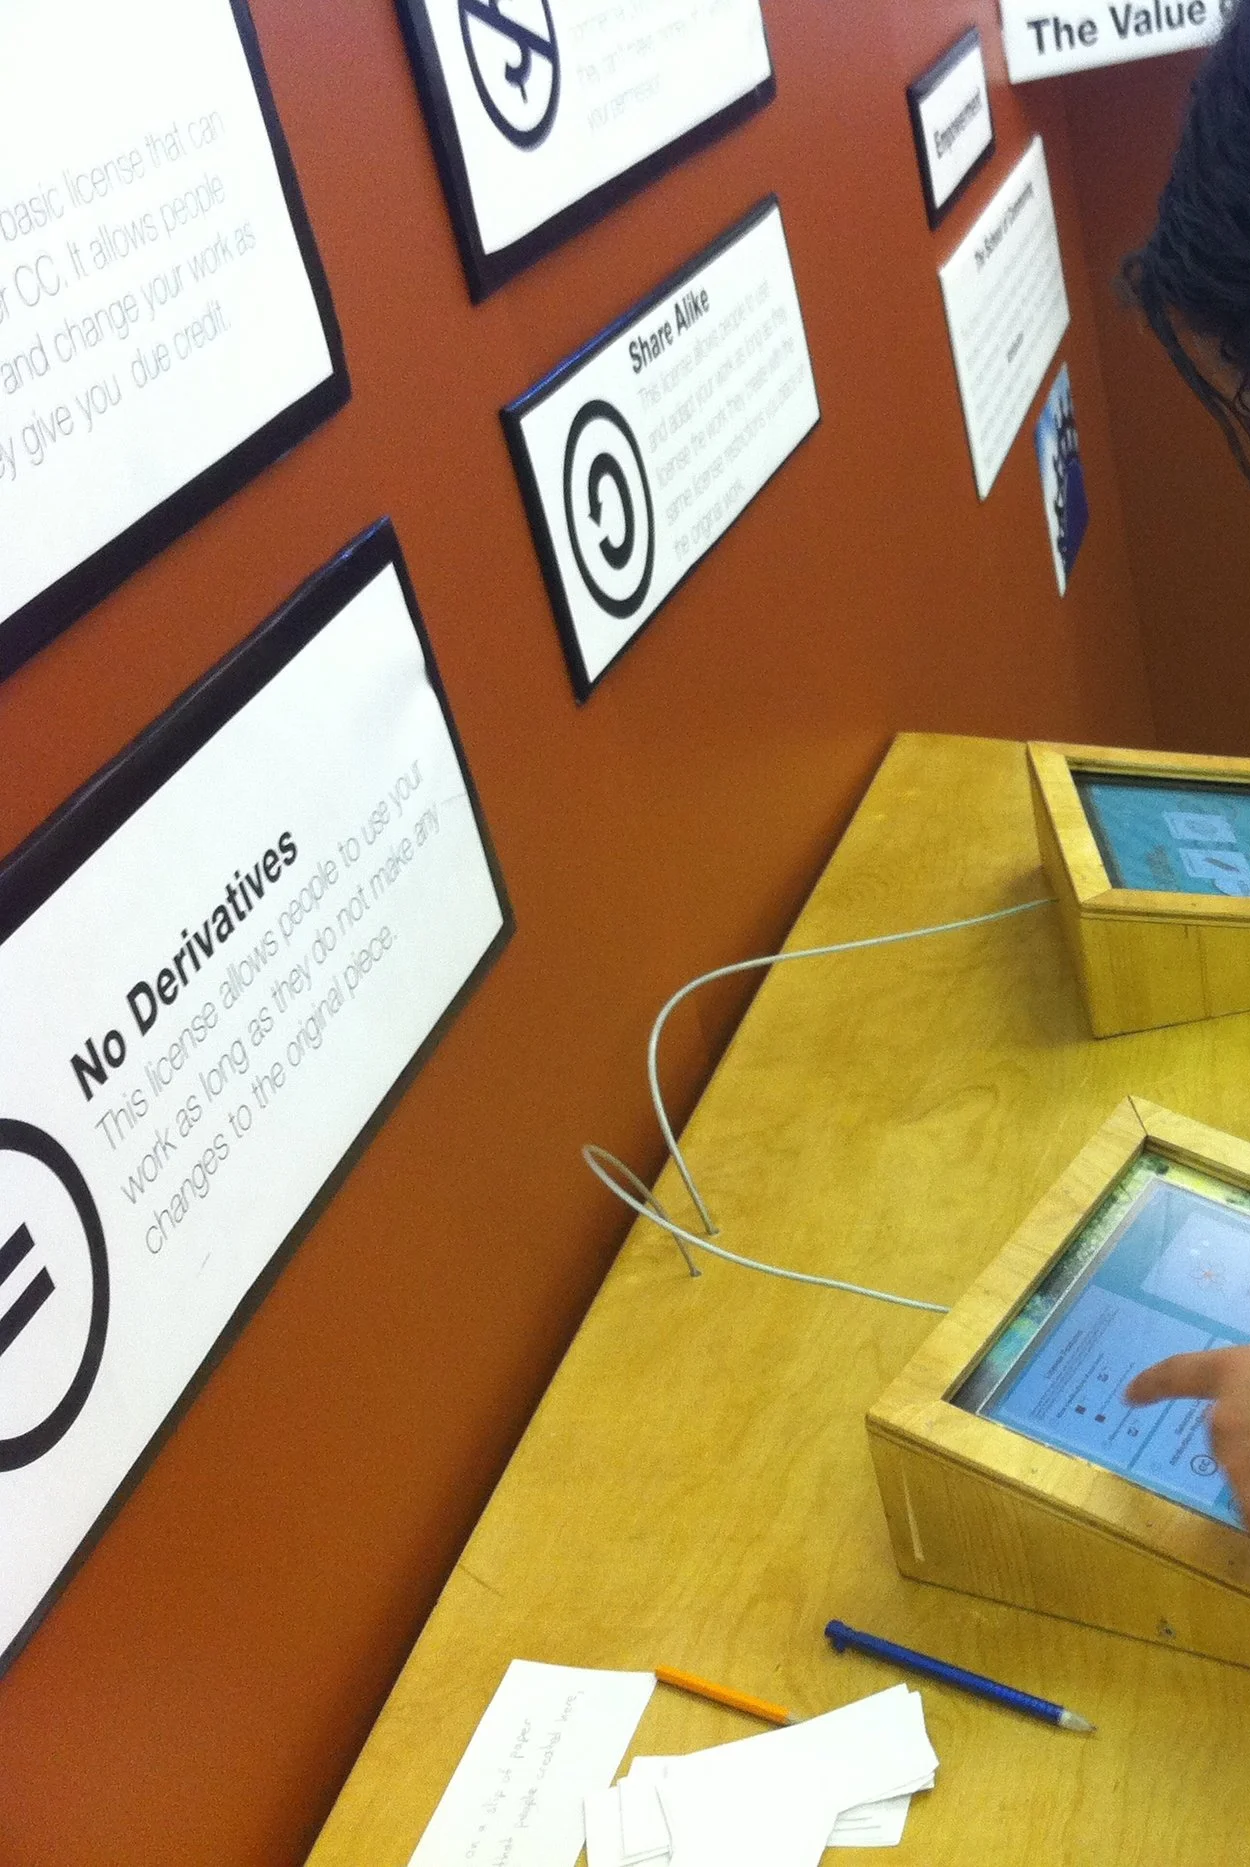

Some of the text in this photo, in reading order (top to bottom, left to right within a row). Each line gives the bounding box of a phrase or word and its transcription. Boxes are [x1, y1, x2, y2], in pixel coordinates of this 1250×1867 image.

[1027, 17, 1099, 55] The
[1109, 0, 1207, 40] Value
[62, 148, 145, 207] license
[144, 122, 187, 168] that
[188, 111, 223, 149] can
[89, 213, 159, 270] allows
[159, 173, 225, 238] people
[0, 222, 256, 395] and change your work as
[629, 290, 710, 374] Share Alike
[21, 404, 74, 466] give
[74, 374, 122, 433] you
[131, 343, 171, 389] due
[70, 831, 297, 1102] No Derivatives
[94, 760, 422, 1151] This license allows people to use your
[120, 804, 439, 1205] work as long as they do not make any
[145, 926, 397, 1255] changes to the original piece.
[509, 1718, 533, 1759] paper
